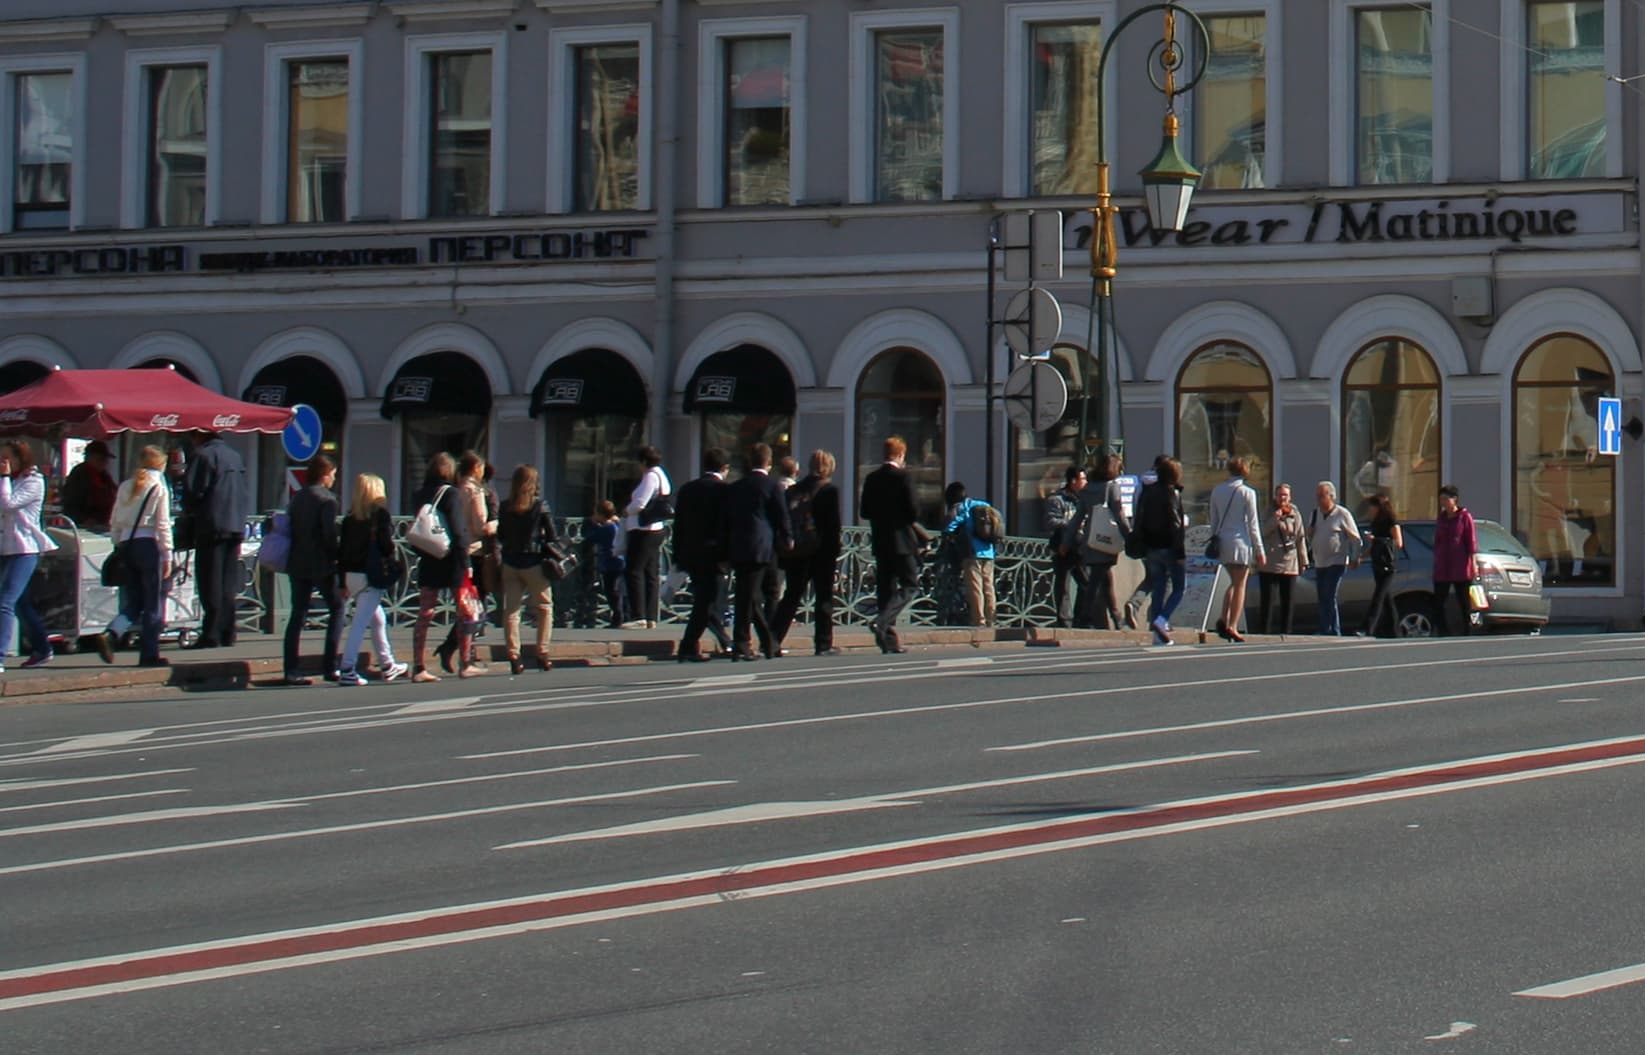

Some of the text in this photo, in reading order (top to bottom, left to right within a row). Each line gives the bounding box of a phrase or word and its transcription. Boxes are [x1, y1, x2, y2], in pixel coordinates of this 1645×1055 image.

[1335, 200, 1577, 243] Matinique
[544, 385, 578, 400] LAB
[696, 383, 731, 398] LAB
[212, 413, 241, 428] Coca-Cola
